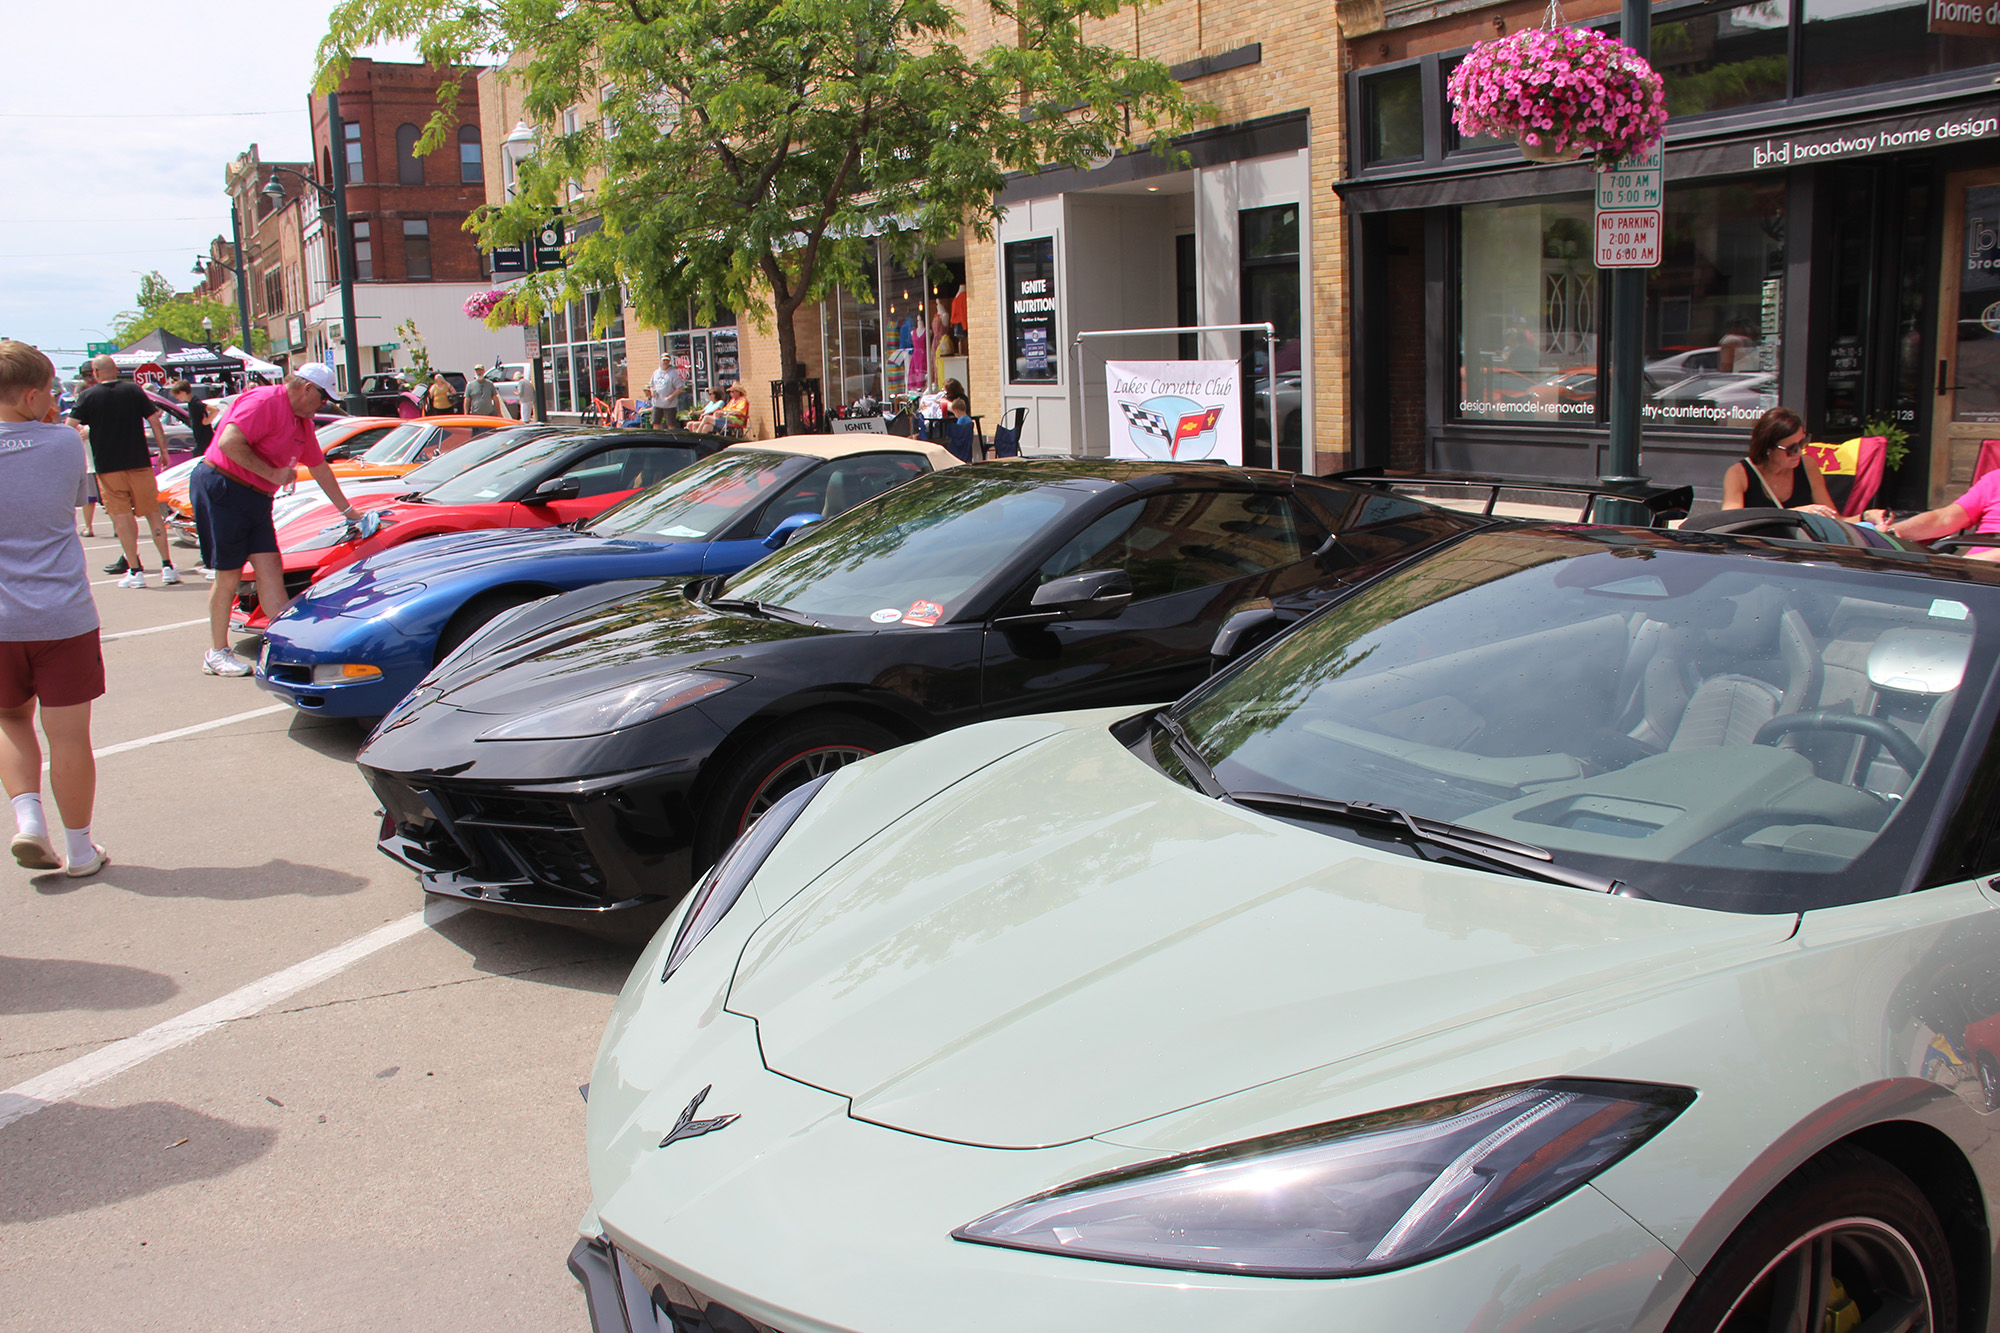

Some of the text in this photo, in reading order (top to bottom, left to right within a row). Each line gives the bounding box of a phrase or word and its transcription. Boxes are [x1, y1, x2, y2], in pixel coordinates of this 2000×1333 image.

[1935, 0, 1982, 23] home
[1793, 135, 1876, 159] broadway
[1880, 128, 1931, 147] home
[1935, 117, 1998, 139] design
[1610, 174, 1649, 188] 7:00 AM
[1602, 189, 1657, 203] TO 5:00 PM
[1602, 217, 1655, 229] NO PARKING
[1609, 232, 1647, 245] 2:00 AM
[1602, 247, 1654, 260] TO 6:00 AM
[1021, 279, 1046, 294] IGNITE
[1014, 297, 1055, 314] NUTRITION
[1114, 377, 1232, 395] Lakes Corvette Club
[1897, 410, 1914, 421] 128
[845, 421, 872, 432] IGNITE
